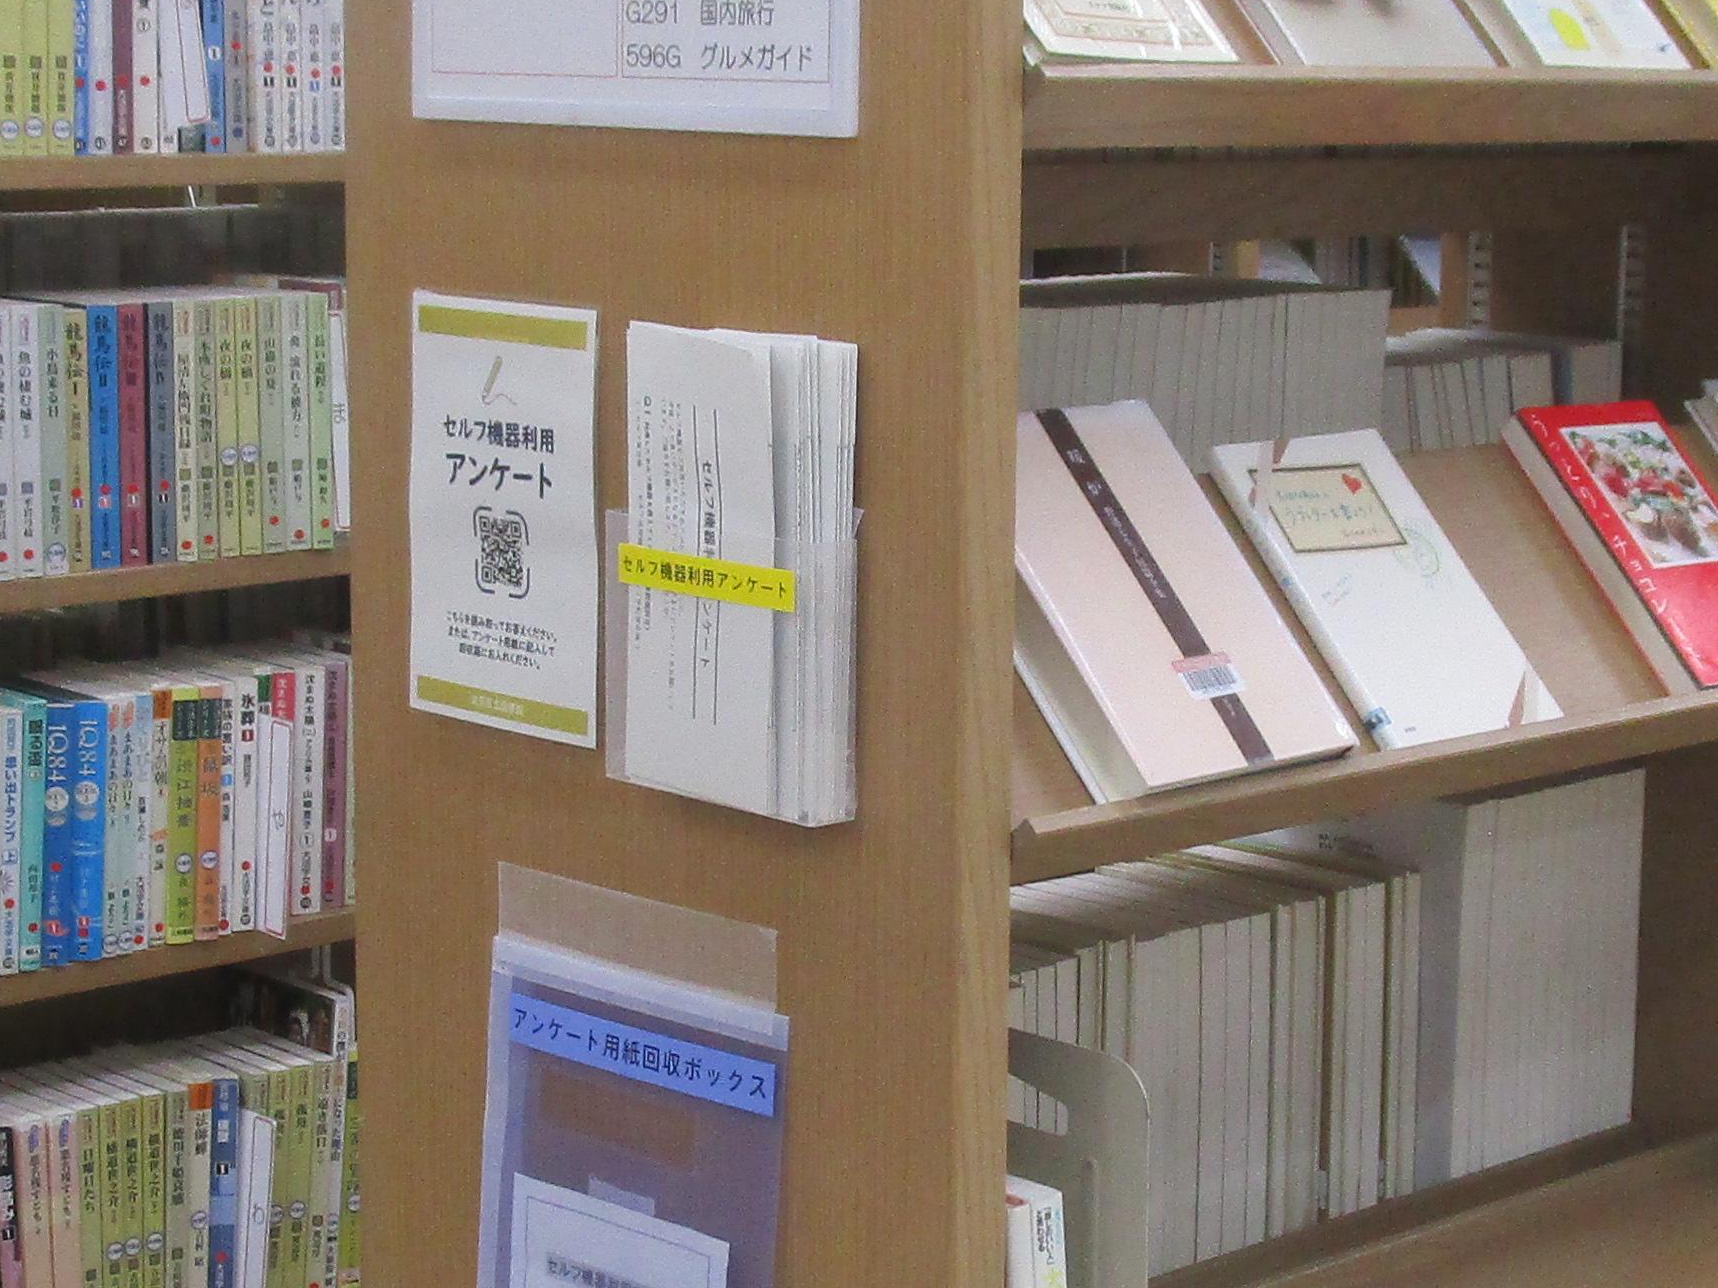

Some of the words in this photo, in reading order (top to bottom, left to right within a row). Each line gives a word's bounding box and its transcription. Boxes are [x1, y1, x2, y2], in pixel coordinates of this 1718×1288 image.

[626, 0, 679, 25] G291
[700, 0, 775, 27] 国内旅行
[627, 42, 682, 69] 596G
[701, 42, 812, 72] グルメガイド
[443, 414, 555, 454] セルフ機器利用
[445, 453, 553, 500] アンケート
[623, 556, 788, 599] セルフ機器利用アンケート
[48, 724, 69, 783] 1Q84
[78, 720, 99, 777] 1Q84
[513, 1007, 768, 1100] アンケート用紙回収ボックス
